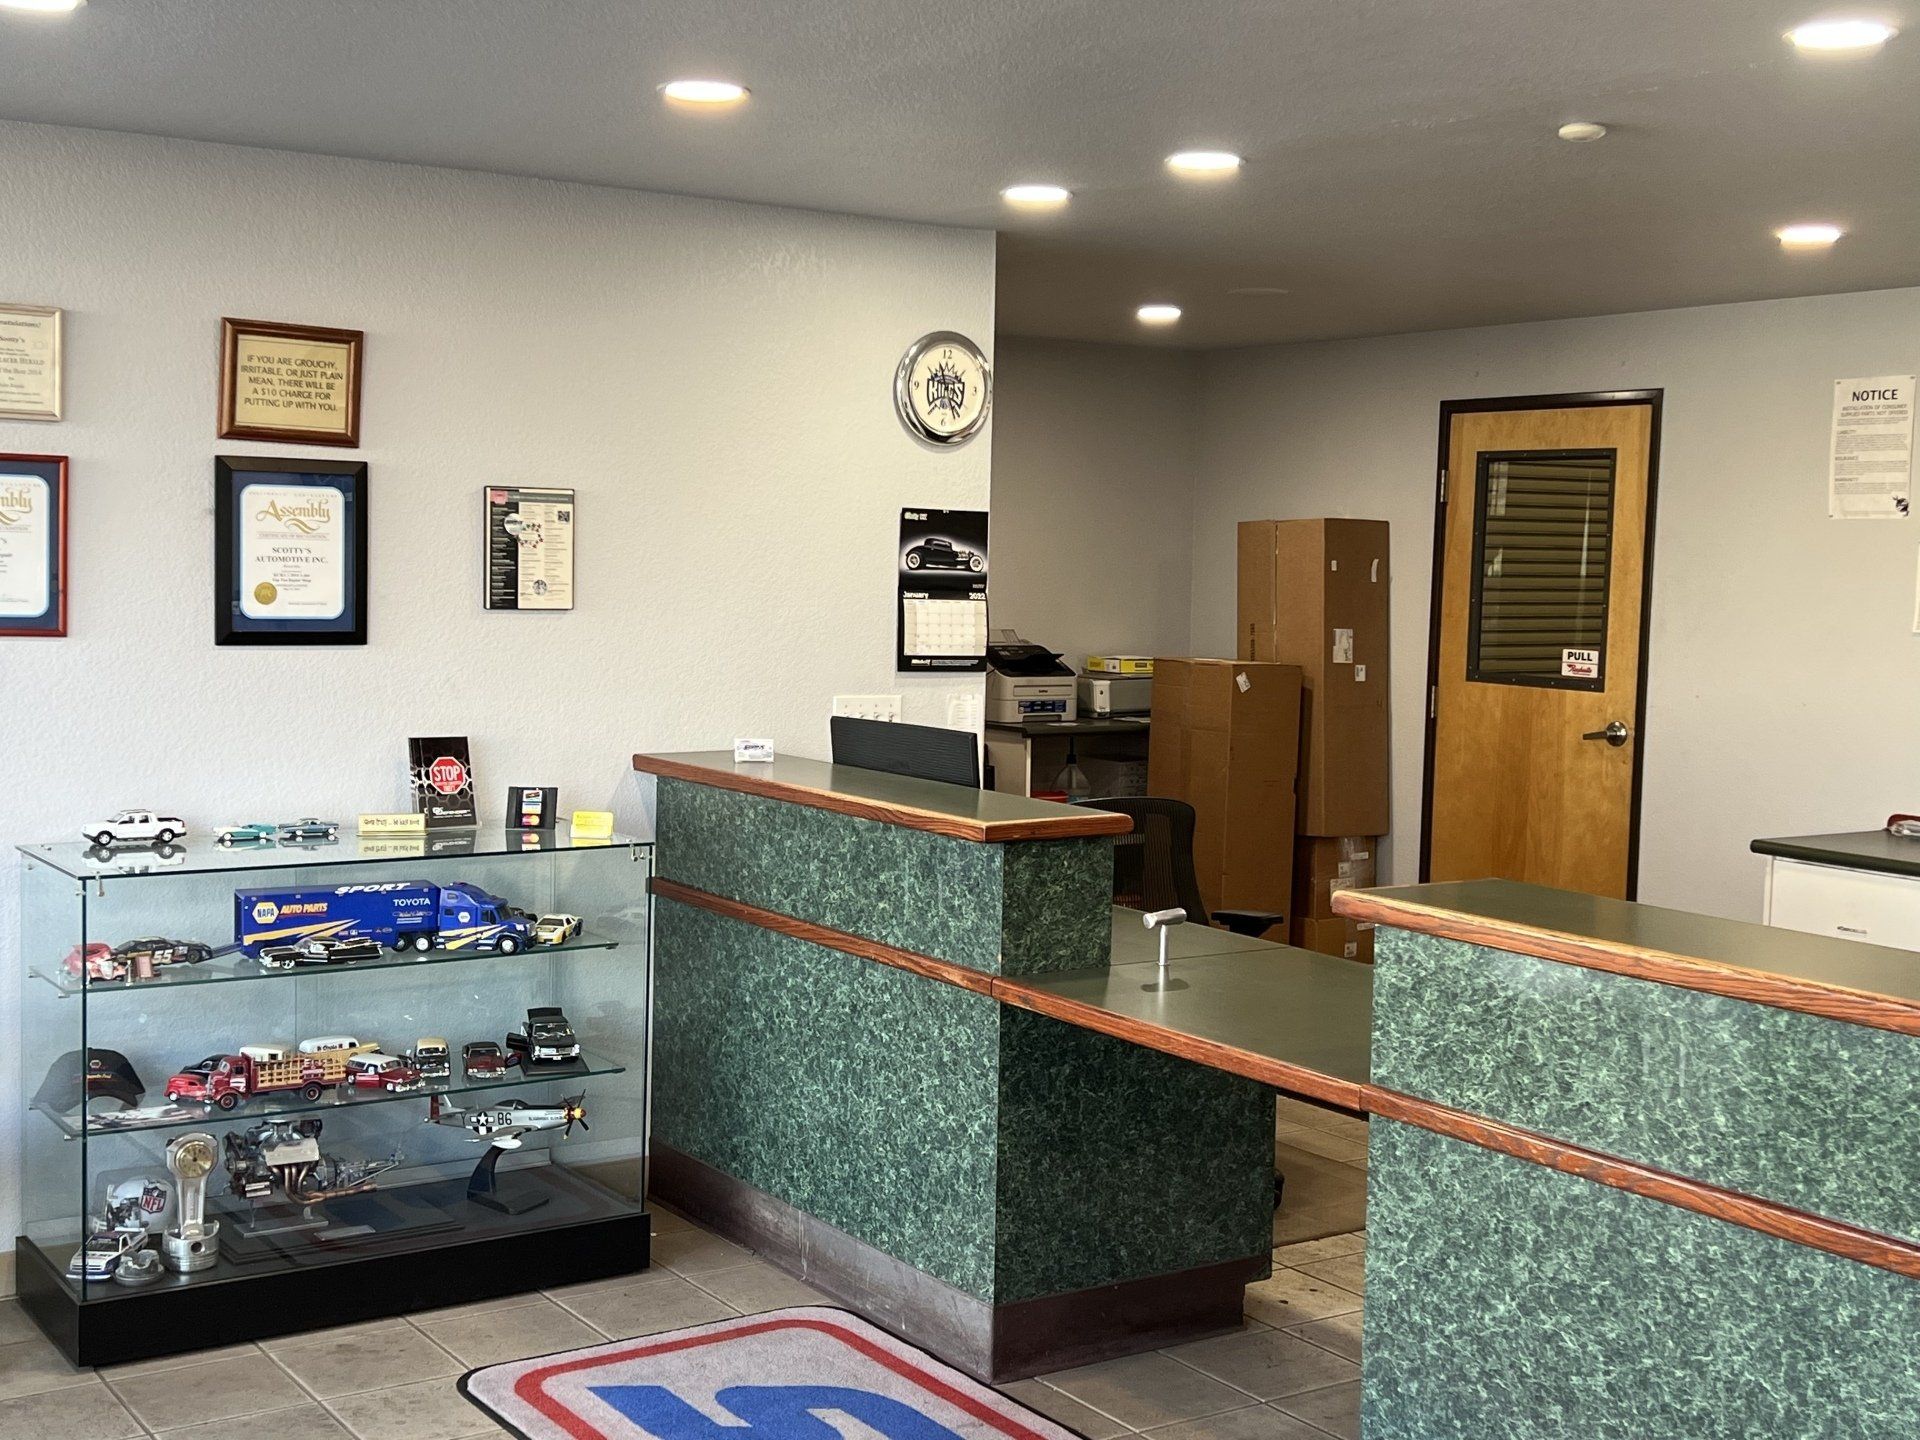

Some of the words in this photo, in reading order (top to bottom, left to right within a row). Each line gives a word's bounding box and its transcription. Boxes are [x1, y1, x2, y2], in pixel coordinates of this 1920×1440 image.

[943, 349, 953, 360] 12
[247, 354, 255, 362] IF
[256, 355, 275, 364] YOU
[277, 357, 293, 366] ARE
[294, 358, 338, 370] GROUCHY,
[285, 368, 298, 377] OR
[299, 370, 318, 379] JUST
[320, 371, 344, 380] PLAIN
[278, 379, 304, 388] THERE
[305, 381, 324, 389] WILL
[326, 382, 336, 390] BE
[914, 380, 920, 390] 9
[972, 386, 978, 396] 3
[261, 388, 277, 396] $10
[279, 389, 313, 399] CHARGE
[315, 392, 331, 400] FOR
[1852, 388, 1899, 402] NOTICE
[243, 397, 280, 407] PUTTING
[282, 400, 294, 408] UP
[295, 401, 317, 410] WITH
[318, 402, 338, 412] YOU.
[940, 418, 946, 426] 6
[256, 499, 331, 524] Assembly
[1567, 651, 1593, 661] PULL
[433, 765, 461, 782] STOP
[334, 882, 411, 895] SPORT
[392, 897, 431, 907] TOYOTA
[257, 908, 275, 918] NAPA
[279, 904, 302, 915] AUTO
[302, 902, 329, 914] PARTS
[153, 949, 174, 965] 55
[497, 1112, 513, 1126] 86
[142, 1197, 165, 1212] NFL
